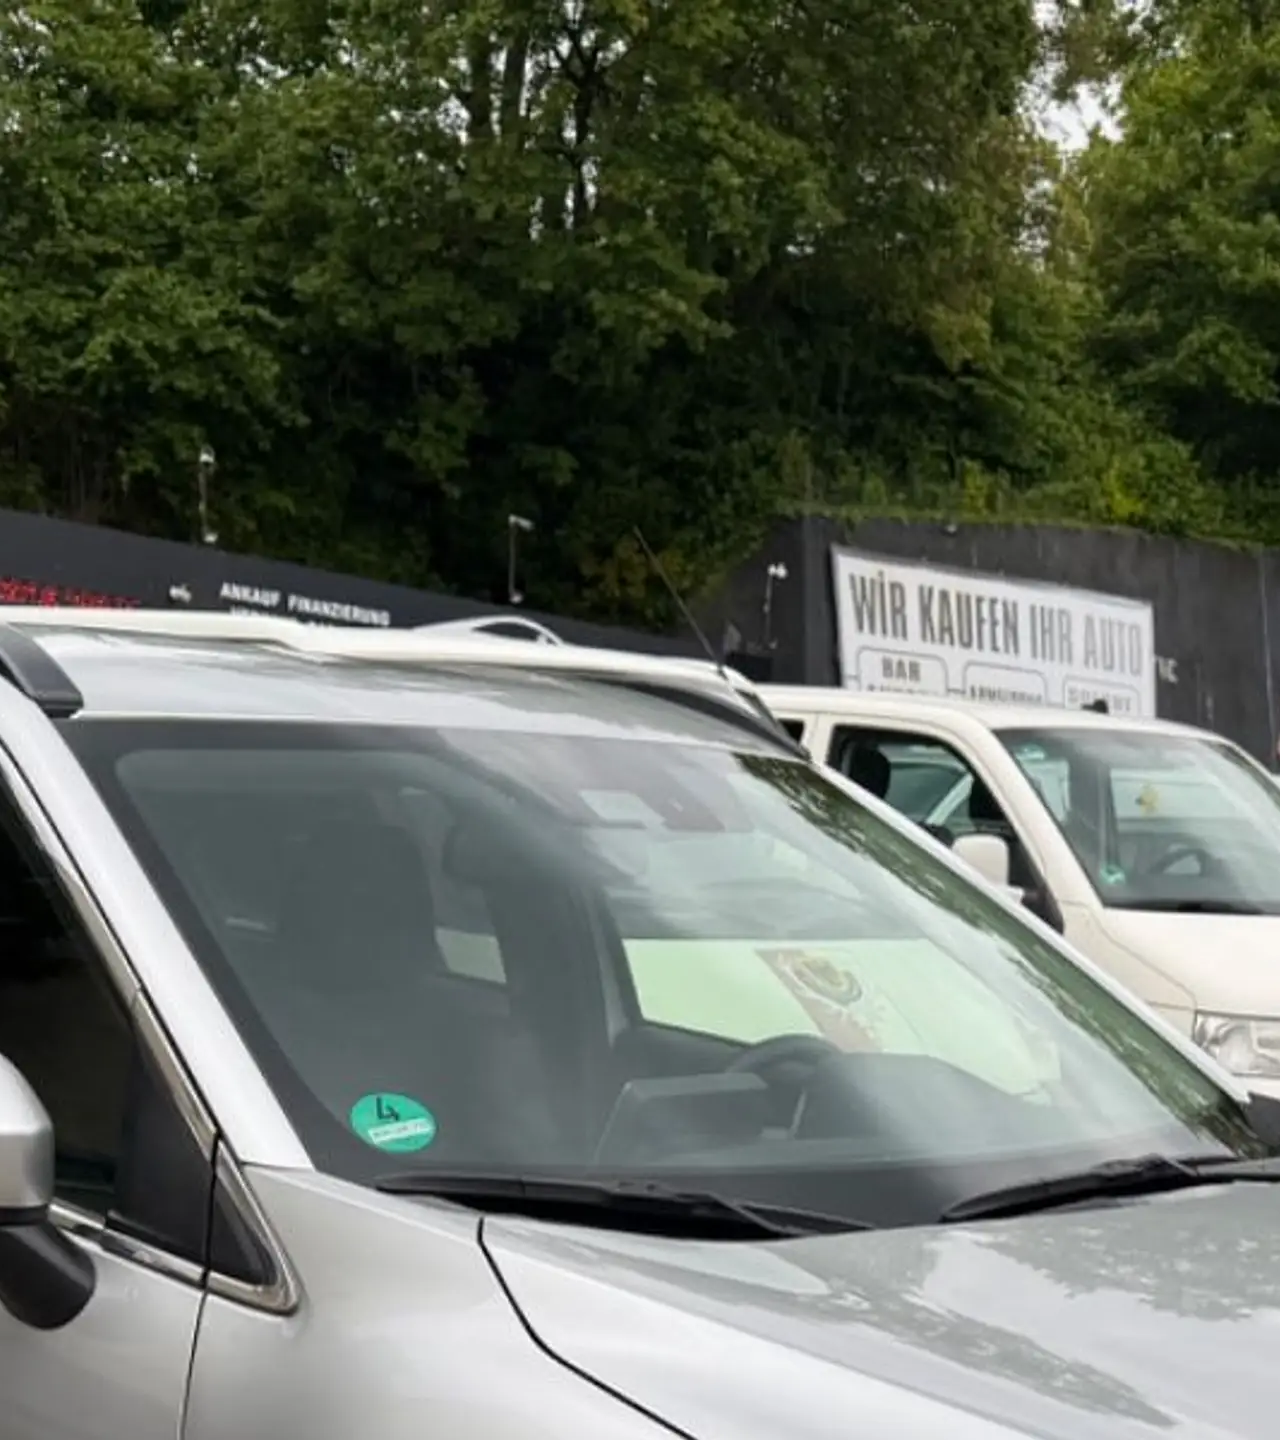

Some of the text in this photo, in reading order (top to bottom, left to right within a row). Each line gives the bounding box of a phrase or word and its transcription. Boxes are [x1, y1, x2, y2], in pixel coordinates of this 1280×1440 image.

[220, 582, 281, 607] ANKAUF
[287, 594, 391, 627] FINANZIERUNG
[918, 584, 1019, 656] KAUFEN
[1030, 604, 1074, 665] IHR
[1083, 614, 1143, 677] AUTO
[882, 655, 921, 681] BAR
[376, 1096, 400, 1121] 4
